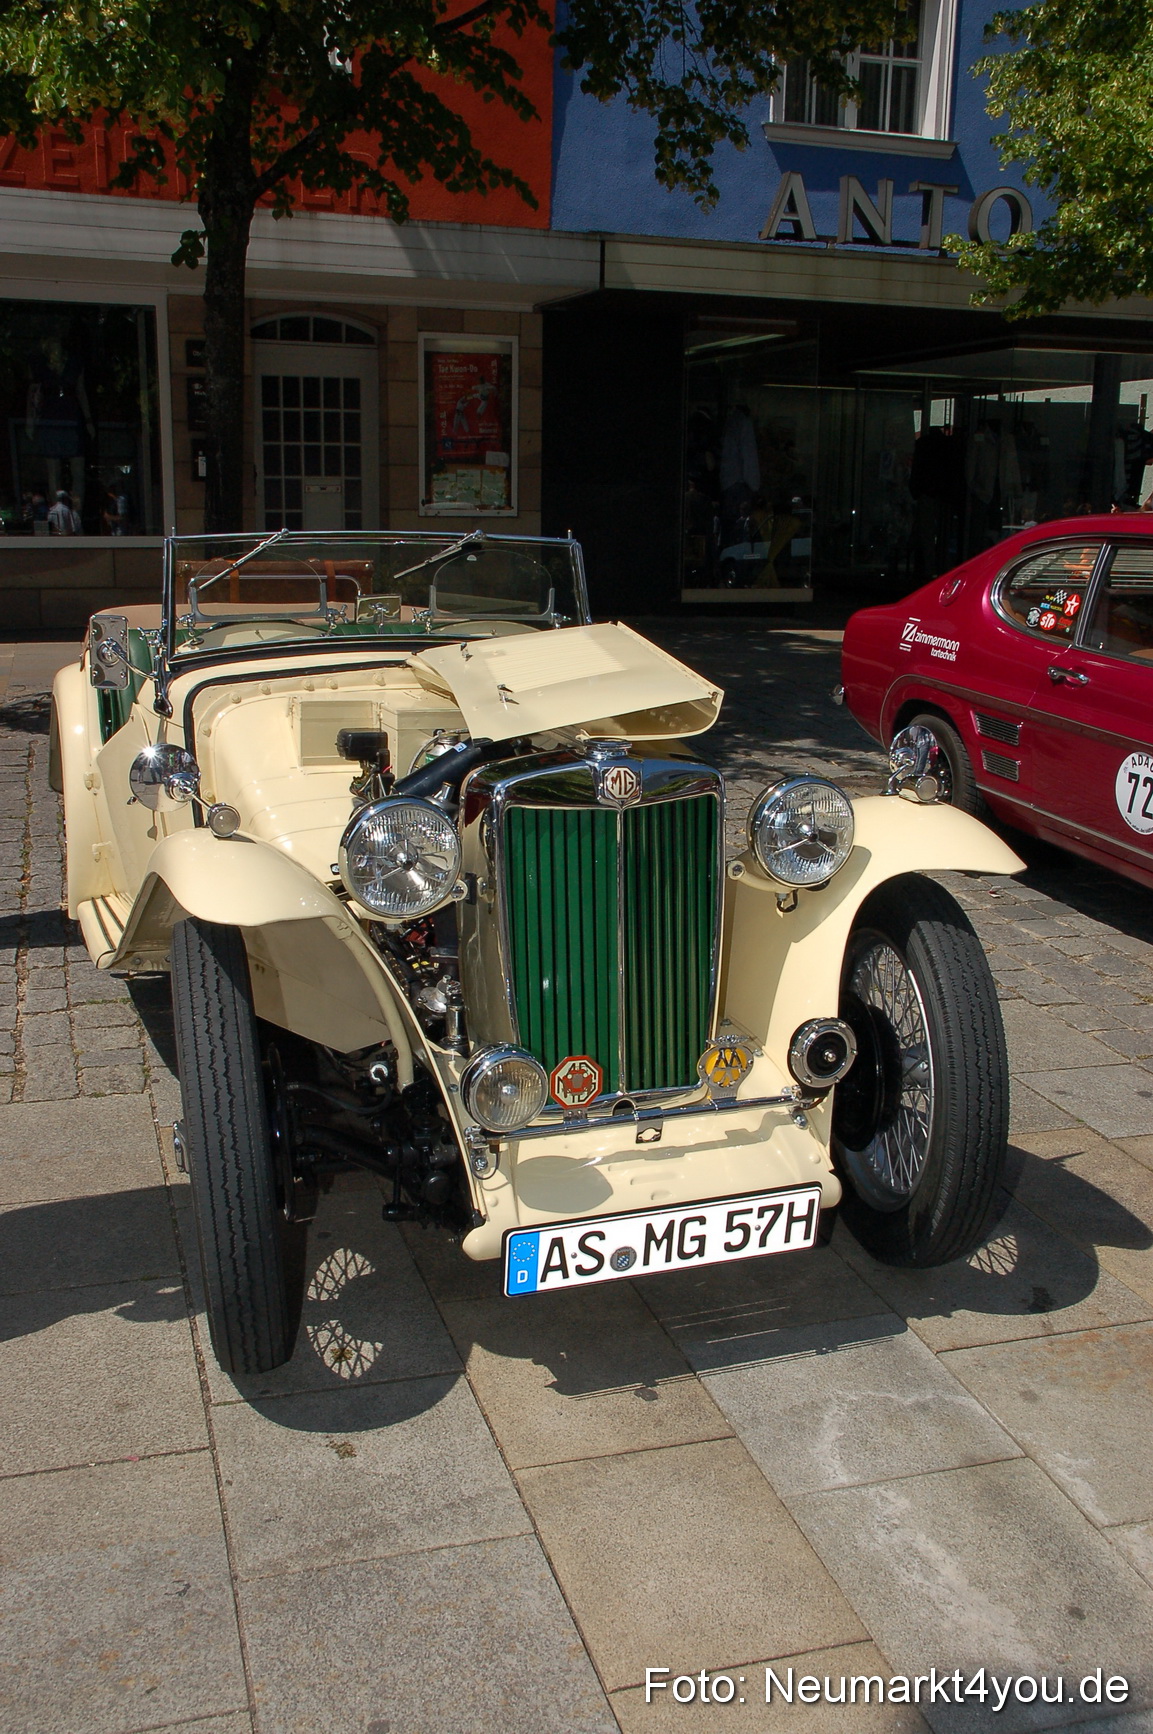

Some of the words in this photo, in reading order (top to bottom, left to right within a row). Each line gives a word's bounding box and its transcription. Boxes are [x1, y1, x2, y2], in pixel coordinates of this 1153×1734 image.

[1040, 613, 1055, 628] STP
[611, 770, 635, 795] MG
[516, 1269, 528, 1284] D
[540, 1230, 606, 1283] AS
[642, 1216, 707, 1266] MG
[723, 1198, 816, 1253] 57H
